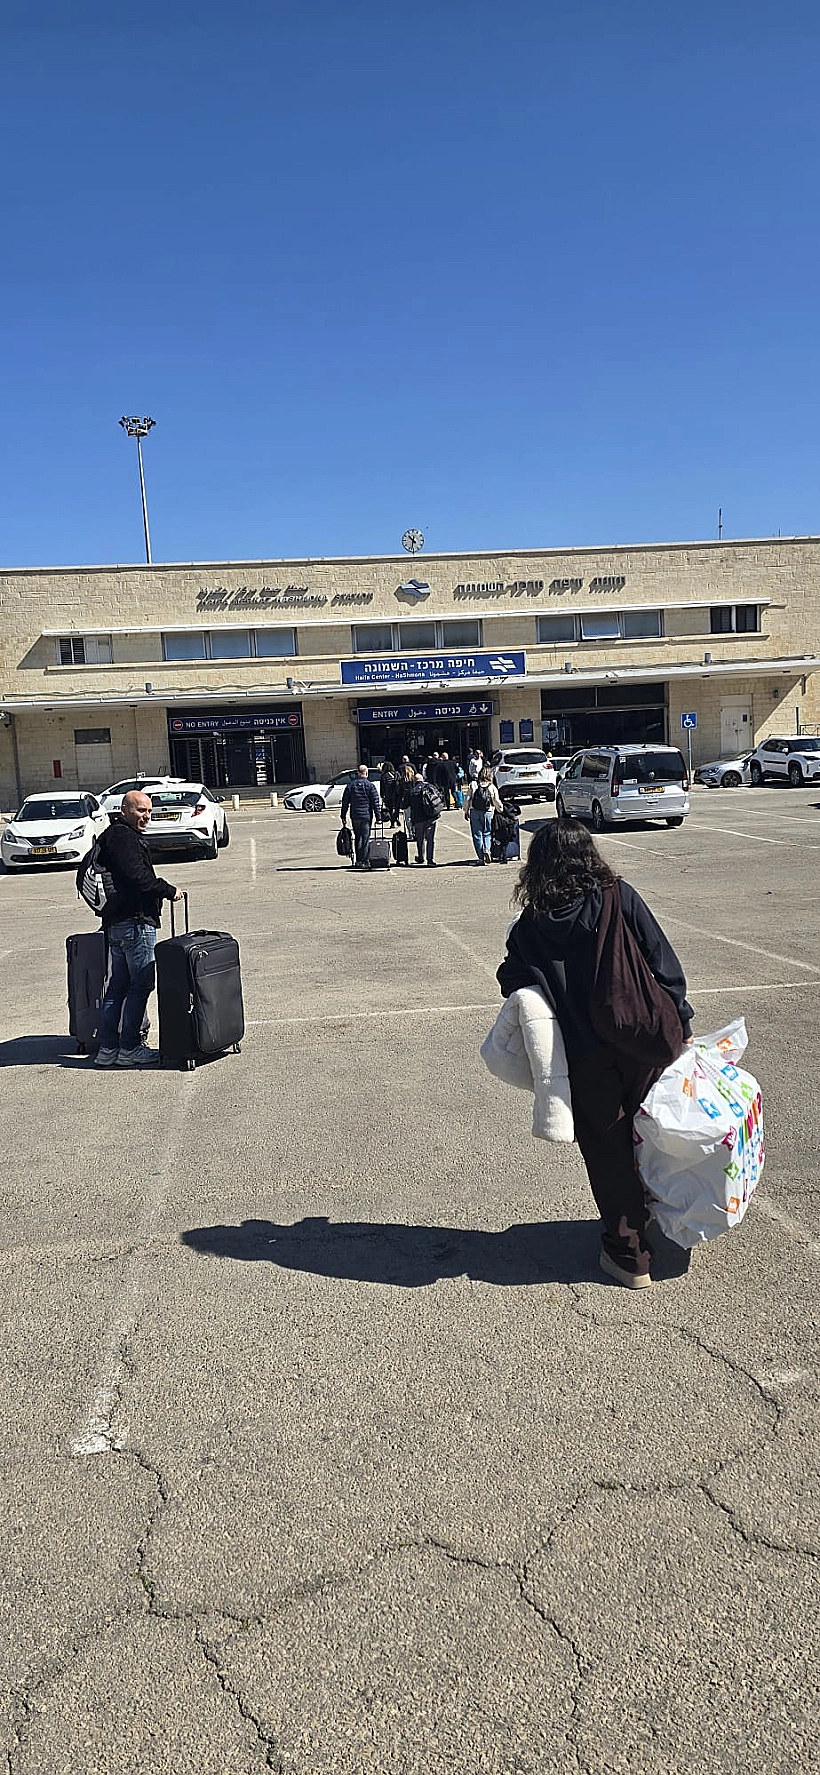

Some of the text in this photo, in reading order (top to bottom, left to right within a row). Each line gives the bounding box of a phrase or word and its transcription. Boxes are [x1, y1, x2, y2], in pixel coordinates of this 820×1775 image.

[364, 662, 408, 673] השמונה
[417, 659, 444, 669] מרכז
[448, 658, 475, 668] חיפה
[372, 710, 399, 718] ENTRY
[408, 709, 427, 718] دخول
[434, 707, 461, 716] כניסה
[253, 717, 286, 726] אין כניסה
